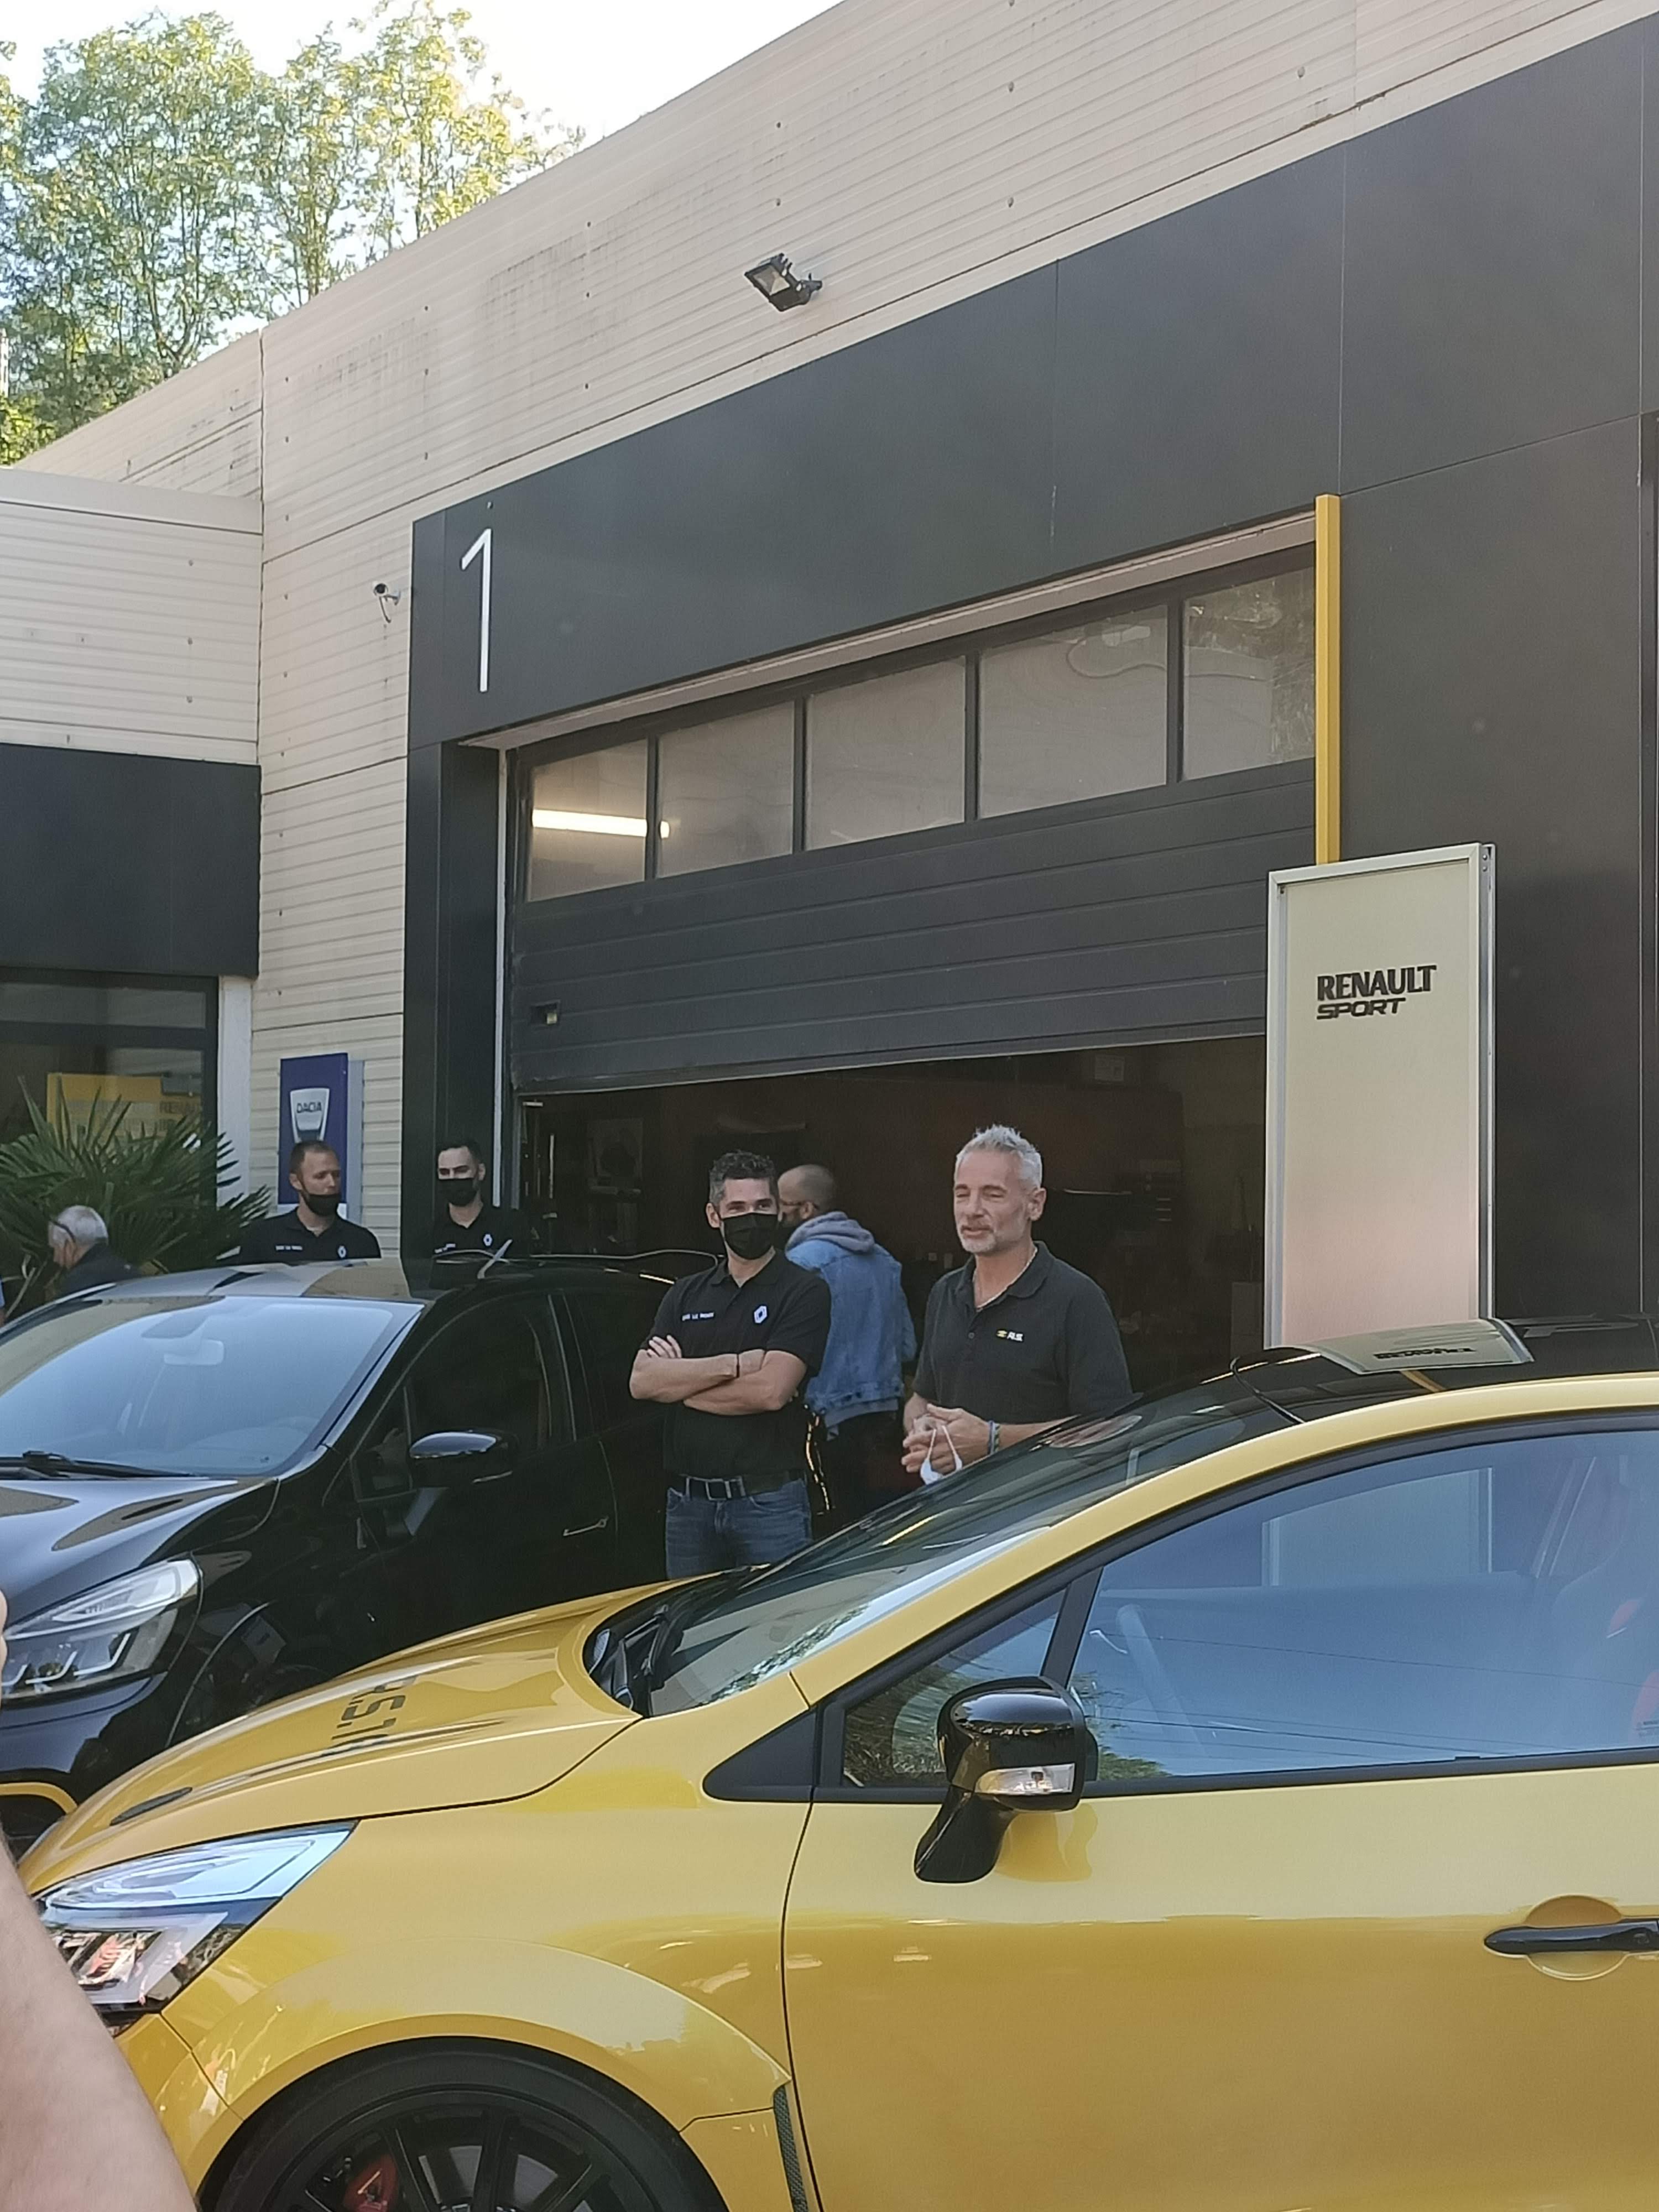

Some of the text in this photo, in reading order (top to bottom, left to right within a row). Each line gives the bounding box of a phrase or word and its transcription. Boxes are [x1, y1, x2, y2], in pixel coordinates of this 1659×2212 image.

[461, 528, 492, 692] 1
[1317, 964, 1437, 1001] RENAULT
[1316, 997, 1406, 1020] SPORT
[296, 1102, 322, 1114] DACIA
